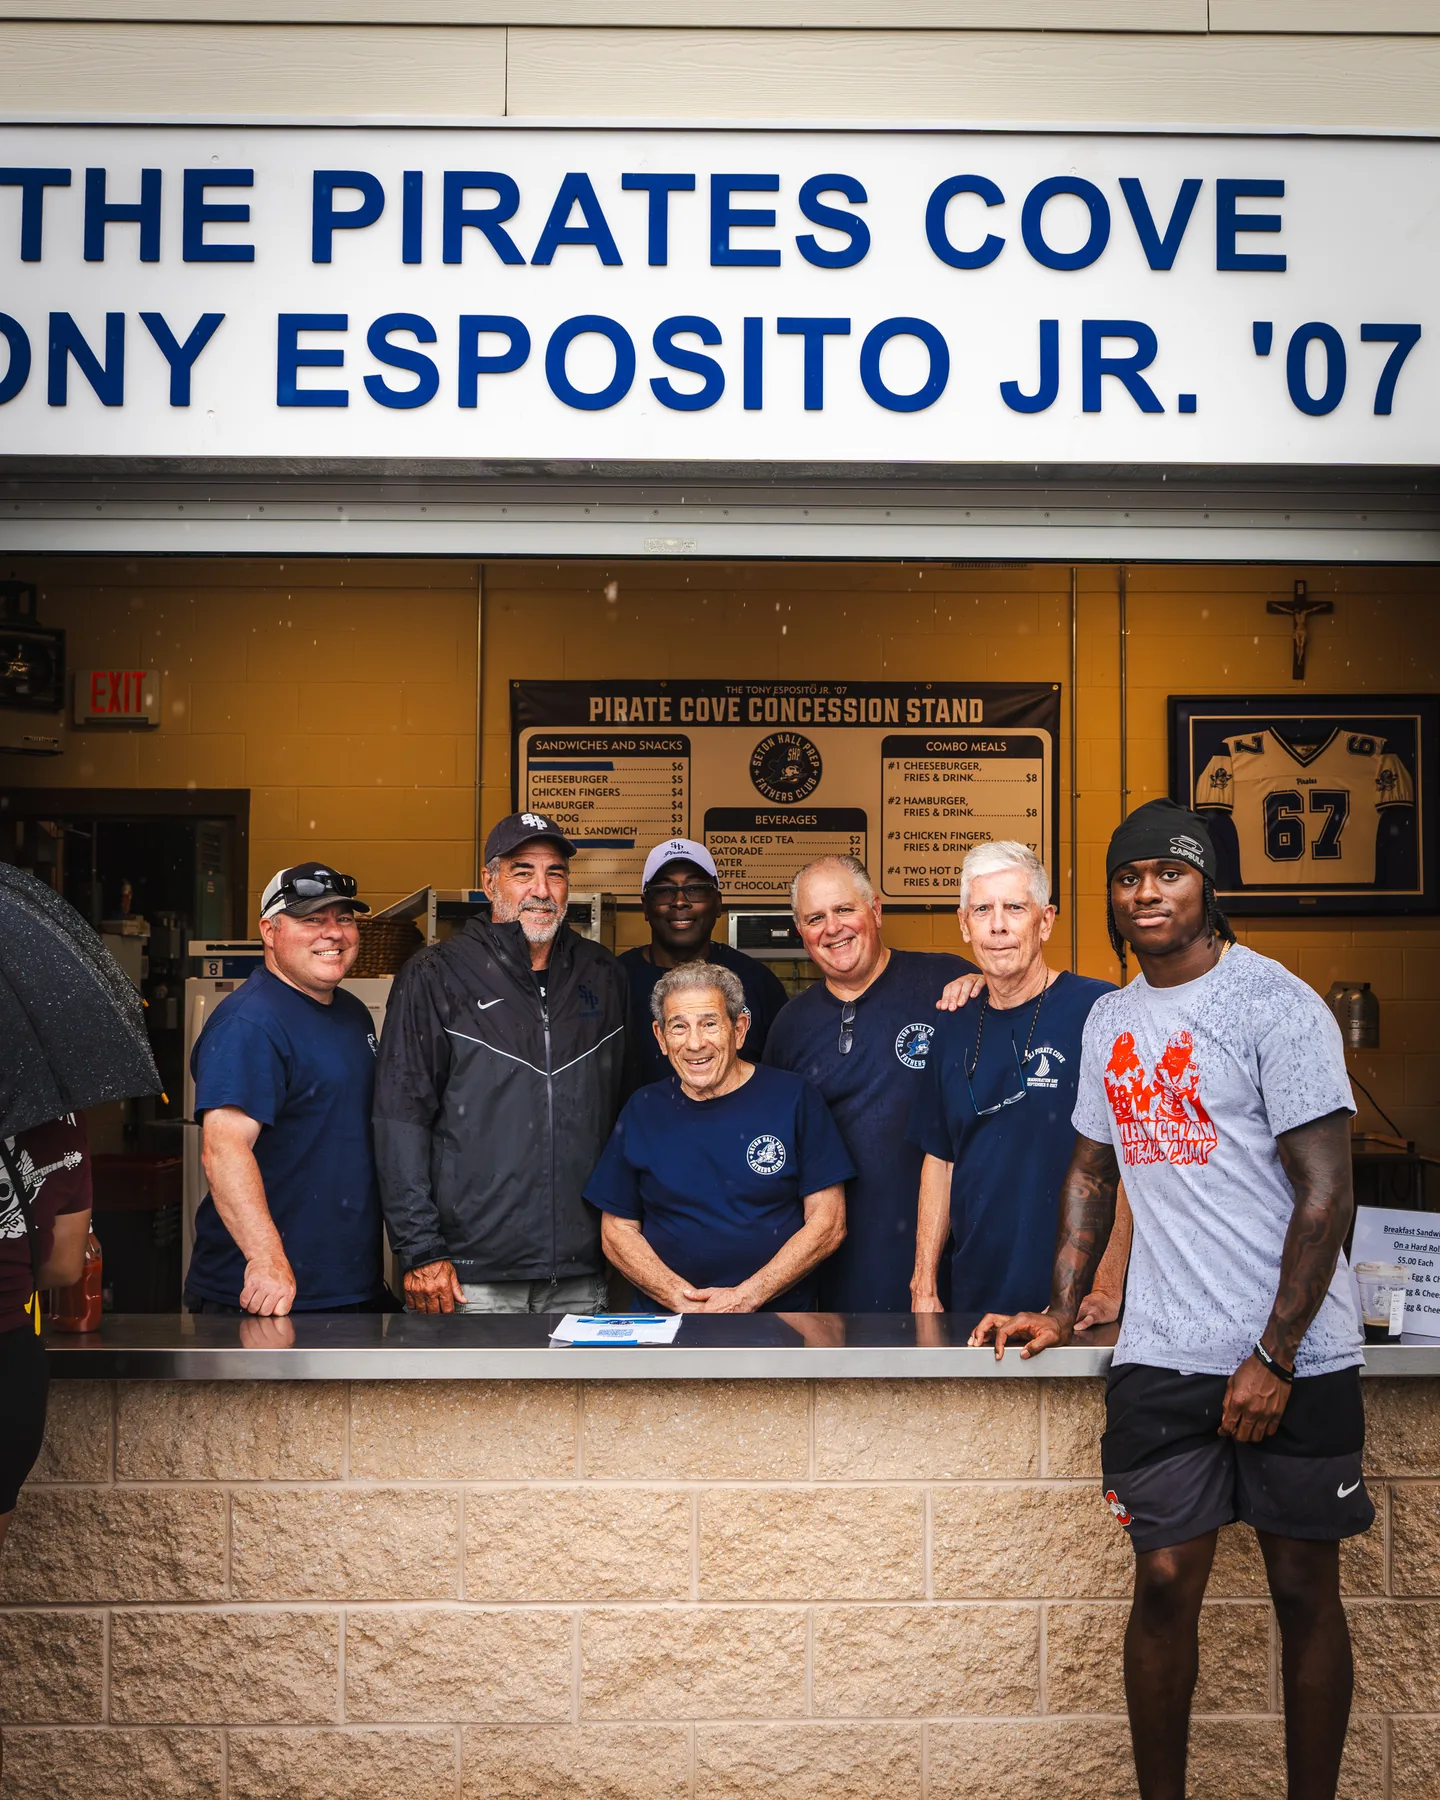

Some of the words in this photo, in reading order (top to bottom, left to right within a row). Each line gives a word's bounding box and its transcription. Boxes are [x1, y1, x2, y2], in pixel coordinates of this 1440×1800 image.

[0, 167, 255, 262] THE
[312, 170, 871, 269] PIRATES
[925, 174, 1287, 272] COVE
[0, 312, 226, 407] NY
[276, 312, 950, 412] ESPOSITO
[999, 319, 1198, 414] JR.
[1252, 321, 1422, 416] '07
[90, 671, 146, 713] EXIT
[725, 686, 743, 694] THE
[746, 686, 771, 694] TONY
[774, 686, 817, 695] ESPOSITO
[819, 686, 831, 694] JR.
[588, 697, 672, 722] PIRATE
[679, 697, 740, 722] COVE
[748, 697, 899, 722] CONCESSION
[906, 698, 984, 723] STAND
[536, 740, 608, 750] SANDWICHES
[611, 740, 636, 750] AND
[639, 740, 683, 750] SNACKS
[926, 742, 968, 751] COMBO
[971, 742, 1007, 751] MEALS
[752, 738, 776, 767] SETON
[777, 734, 802, 747] HALL
[802, 742, 820, 767] PREP
[672, 762, 683, 771] $6
[888, 762, 900, 770] #1
[903, 761, 982, 772] CHEESEBURGER,
[532, 775, 608, 784] CHEESEBURGER
[672, 775, 683, 784] $5
[904, 774, 930, 782] FRIES
[932, 774, 940, 782] &
[942, 774, 974, 782] DRINK
[1026, 774, 1037, 783] $8
[532, 788, 576, 797] CHICKEN
[579, 788, 620, 797] FINGERS
[672, 788, 683, 797] $4
[755, 777, 794, 801] FATHERS
[795, 777, 817, 798] CLUB
[532, 801, 595, 810] HAMBURGER
[672, 801, 683, 810] $4
[887, 797, 901, 805] #2
[903, 796, 968, 806] HAMBURGER,
[904, 808, 930, 817] FRIES
[932, 808, 940, 817] &
[942, 808, 974, 817] DRINK
[1026, 808, 1037, 817] $8
[556, 814, 579, 823] DOG
[672, 814, 683, 823] $3
[755, 815, 818, 825] BEVERAGES
[1263, 789, 1350, 862] 67
[560, 827, 581, 835] BALL
[584, 827, 637, 835] SANDWICH
[671, 827, 682, 836] $6
[887, 832, 901, 840] #3
[903, 832, 947, 840] CHICKEN
[950, 832, 994, 841] FINGERS,
[710, 835, 737, 844] SODA
[740, 835, 747, 844] &
[750, 835, 772, 844] ICED
[775, 835, 794, 844] TEA
[849, 836, 861, 845] $2
[709, 847, 763, 855] GATORADE
[849, 847, 861, 856] $2
[904, 843, 930, 852] FRIES
[932, 843, 940, 852] &
[942, 843, 973, 852] DRINK
[1170, 846, 1205, 868] CAPSULE
[717, 870, 746, 878] OFFEE
[887, 866, 901, 875] #4
[903, 866, 927, 875] TWO
[929, 866, 951, 875] HOT
[719, 881, 731, 890] OT
[734, 881, 790, 890] CHOCOLAT
[904, 878, 930, 886] FRIES
[932, 878, 940, 886] &
[942, 878, 961, 886] DRI
[209, 963, 218, 975] 8
[901, 1053, 926, 1067] FATHERS
[1167, 1139, 1218, 1165] CAMP
[1383, 1225, 1415, 1235] Breakfast
[1393, 1241, 1403, 1249] On
[1411, 1243, 1427, 1251] Hard
[1397, 1256, 1416, 1265] $5.00
[1418, 1258, 1434, 1267] Each
[1412, 1273, 1424, 1283] Egg
[1405, 1289, 1414, 1297] gg
[1415, 1288, 1420, 1296] &
[1416, 1304, 1421, 1312] &
